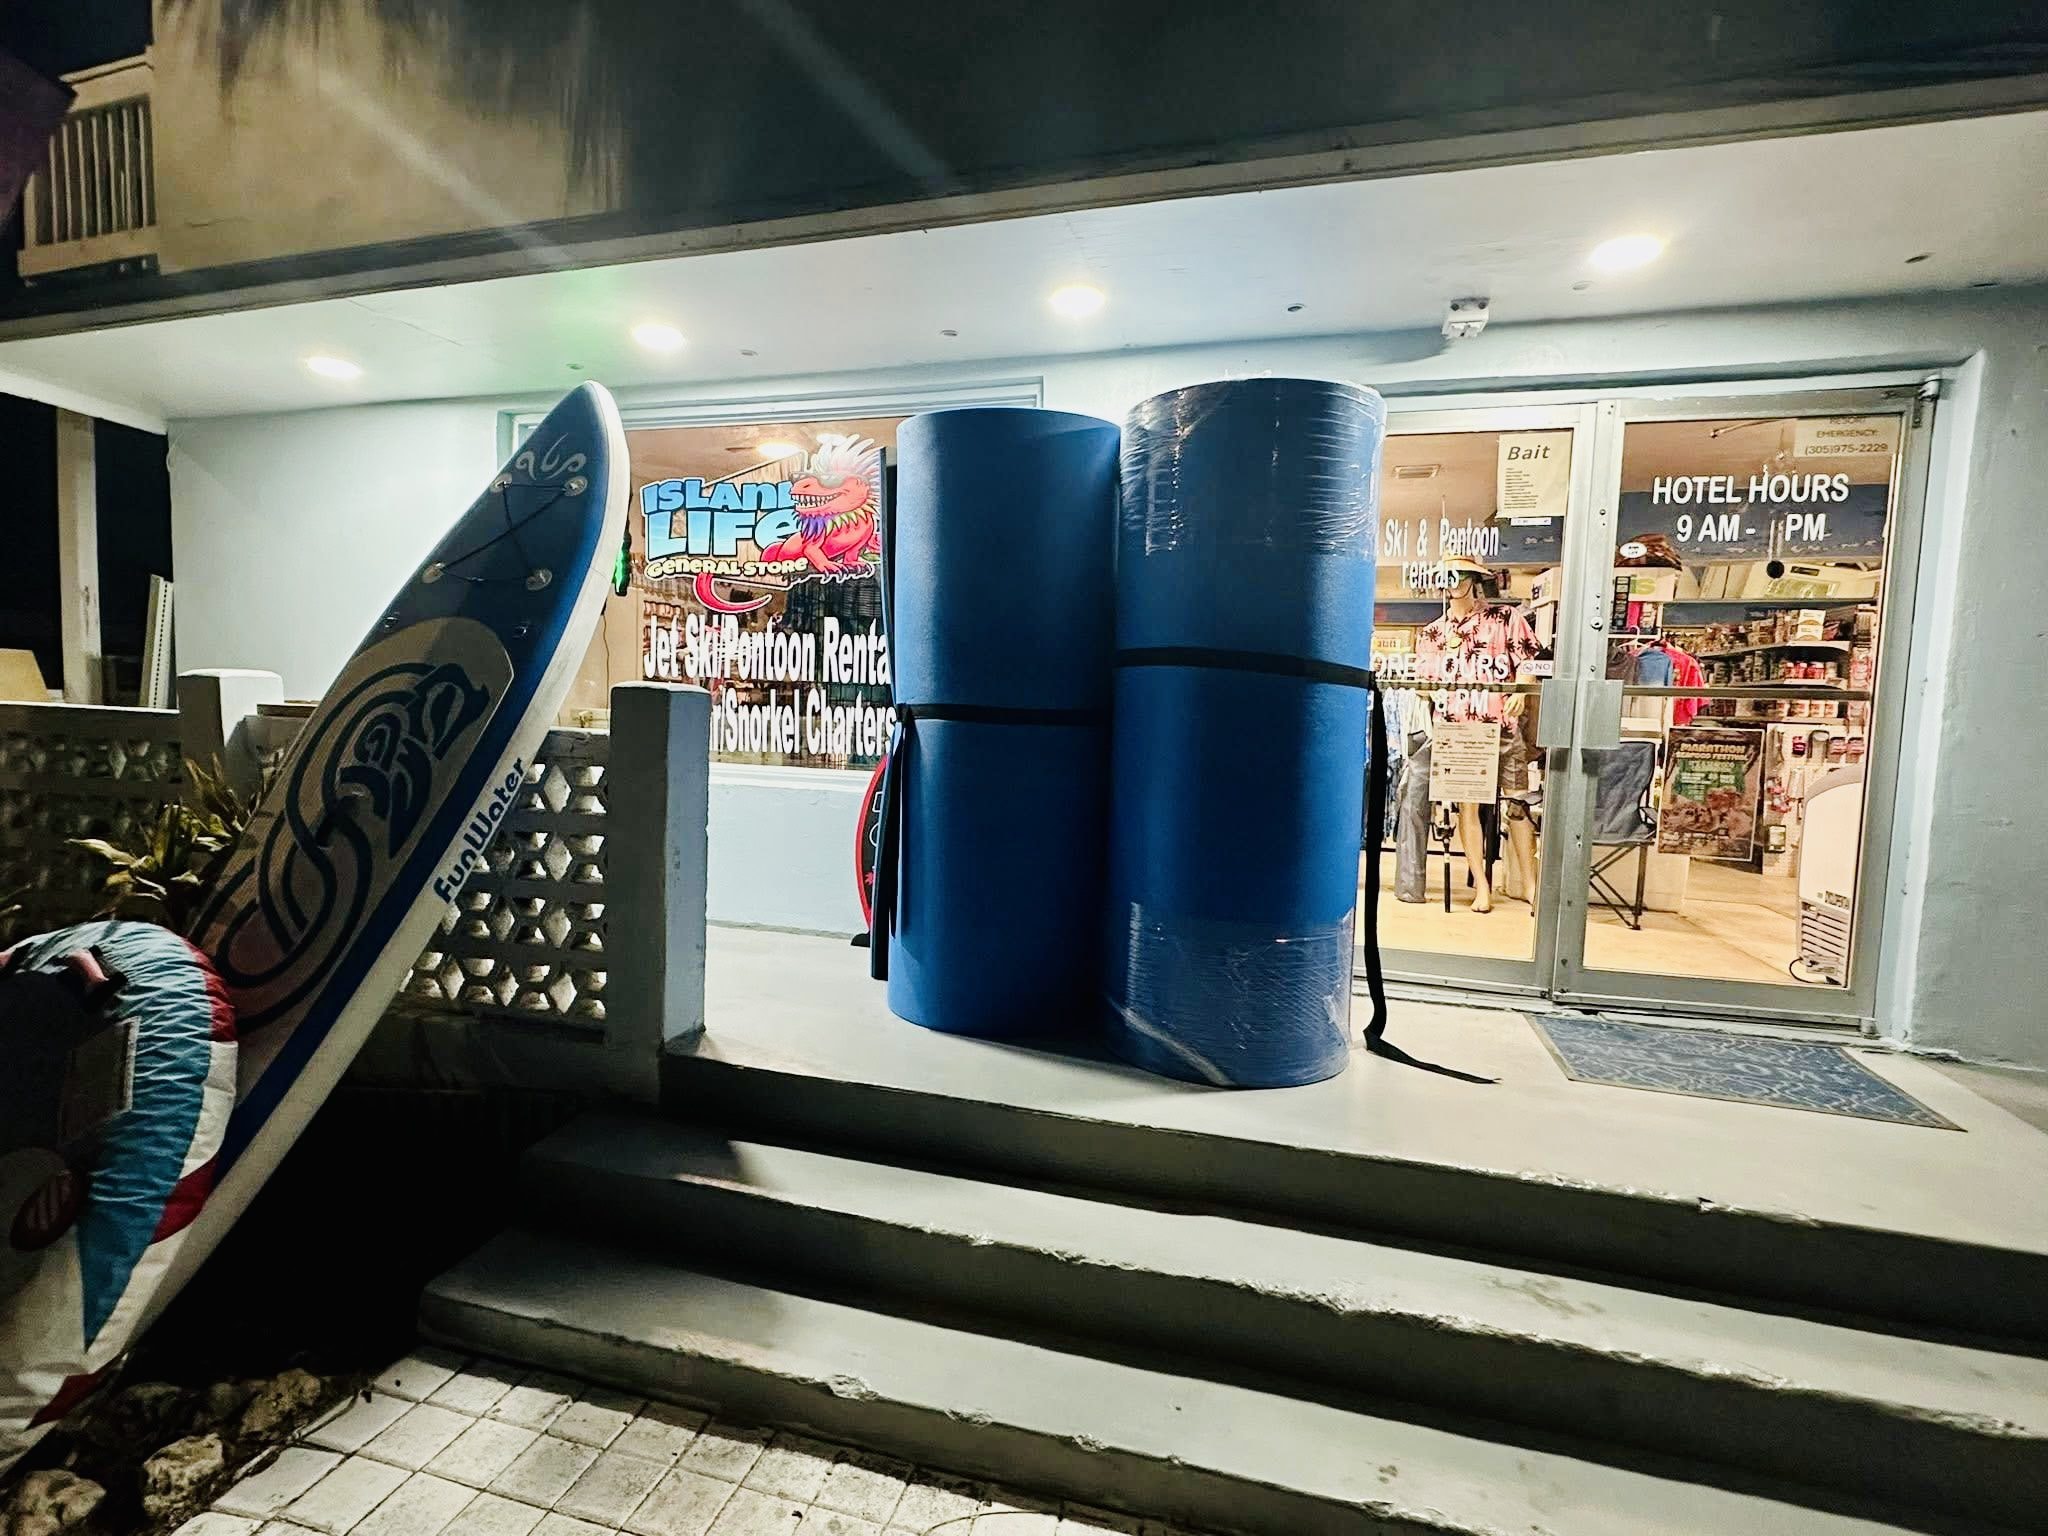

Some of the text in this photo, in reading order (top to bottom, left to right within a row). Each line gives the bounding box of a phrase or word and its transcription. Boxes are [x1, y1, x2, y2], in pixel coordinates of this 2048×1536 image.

[1508, 444, 1550, 460] Bait
[1653, 473, 1849, 504] HOTEL HOURS
[1384, 518, 1499, 557] Ski & Pontoon
[1677, 514, 1693, 543] 9
[1784, 513, 1826, 542] PM
[1402, 560, 1459, 589] rentals
[644, 614, 679, 678] Jet
[806, 688, 897, 757] Charters
